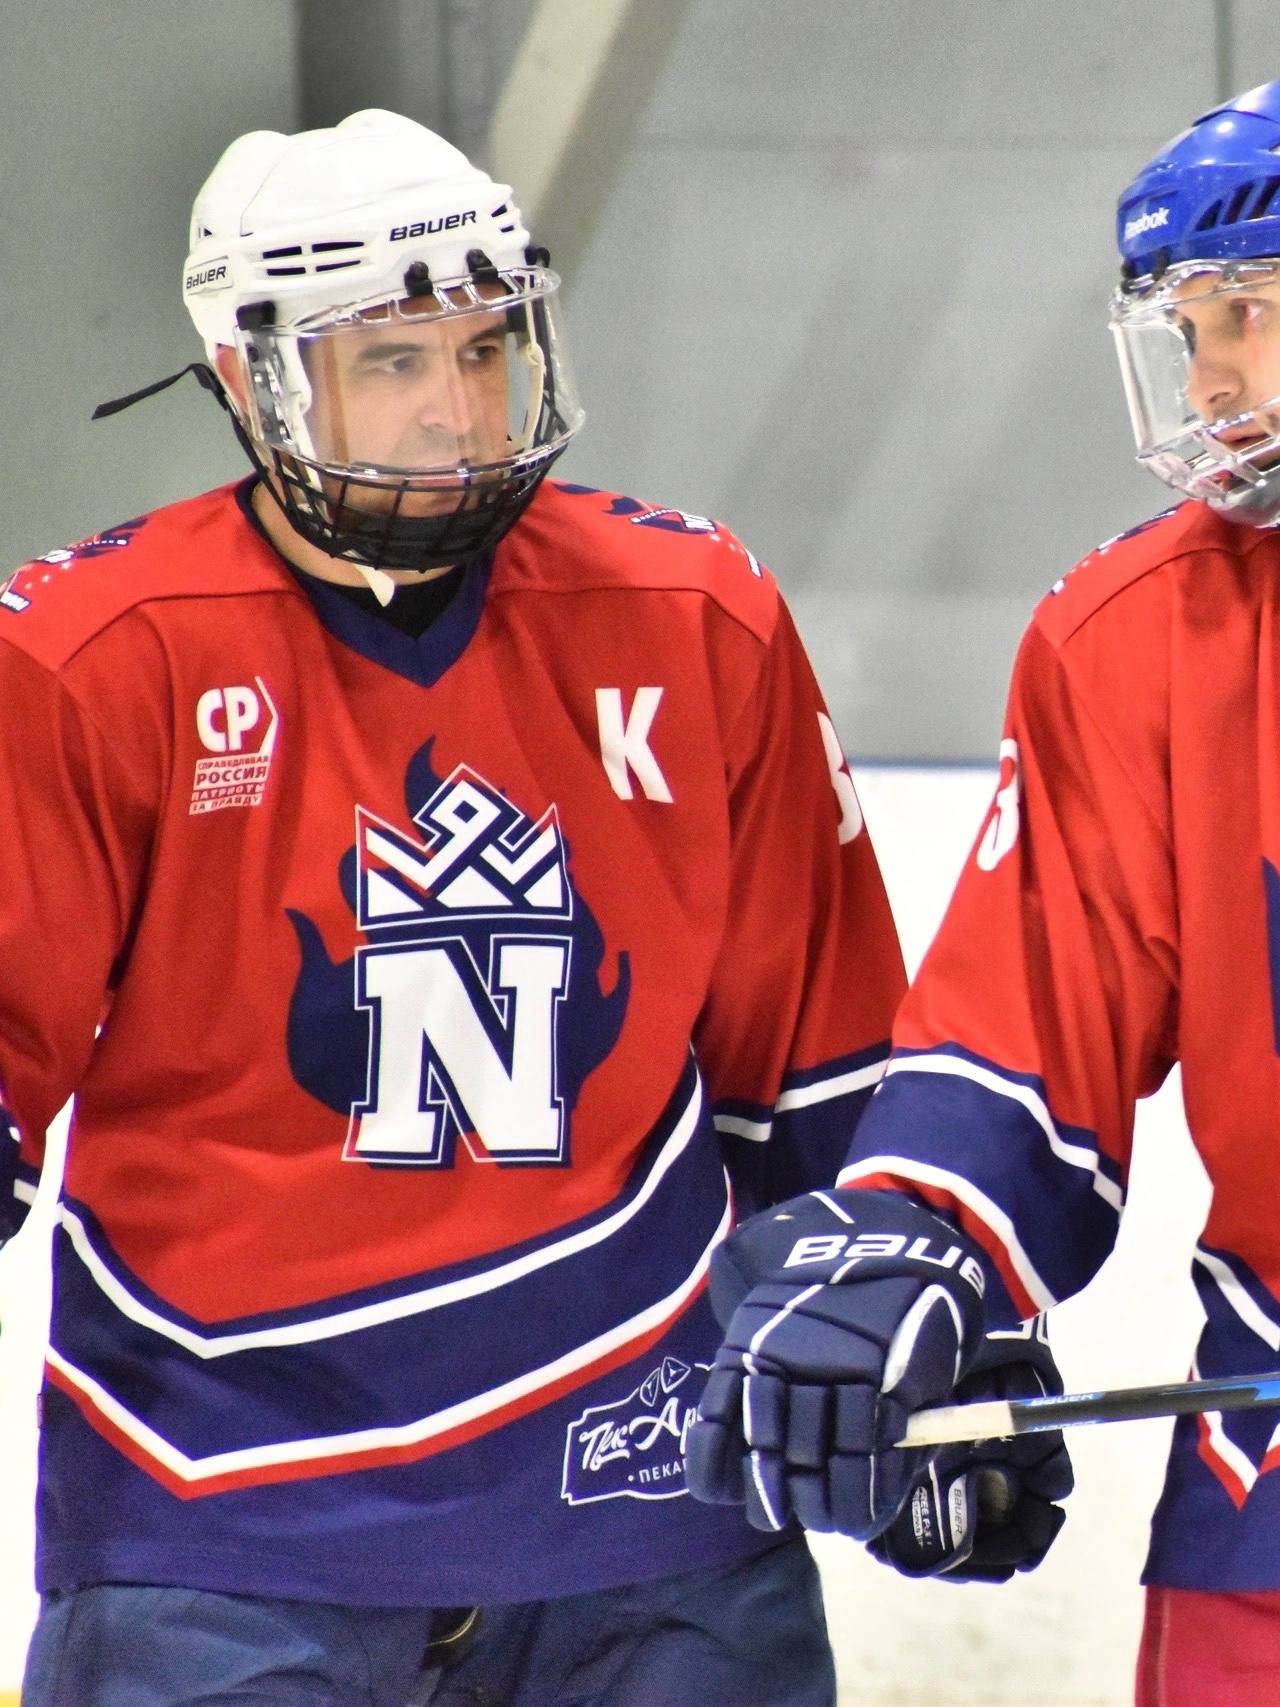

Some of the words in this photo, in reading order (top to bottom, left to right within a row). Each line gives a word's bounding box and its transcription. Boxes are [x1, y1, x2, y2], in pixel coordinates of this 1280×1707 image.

[389, 210, 477, 242] BAUER
[196, 765, 267, 786] РОССИЯ
[350, 942, 567, 1157] N
